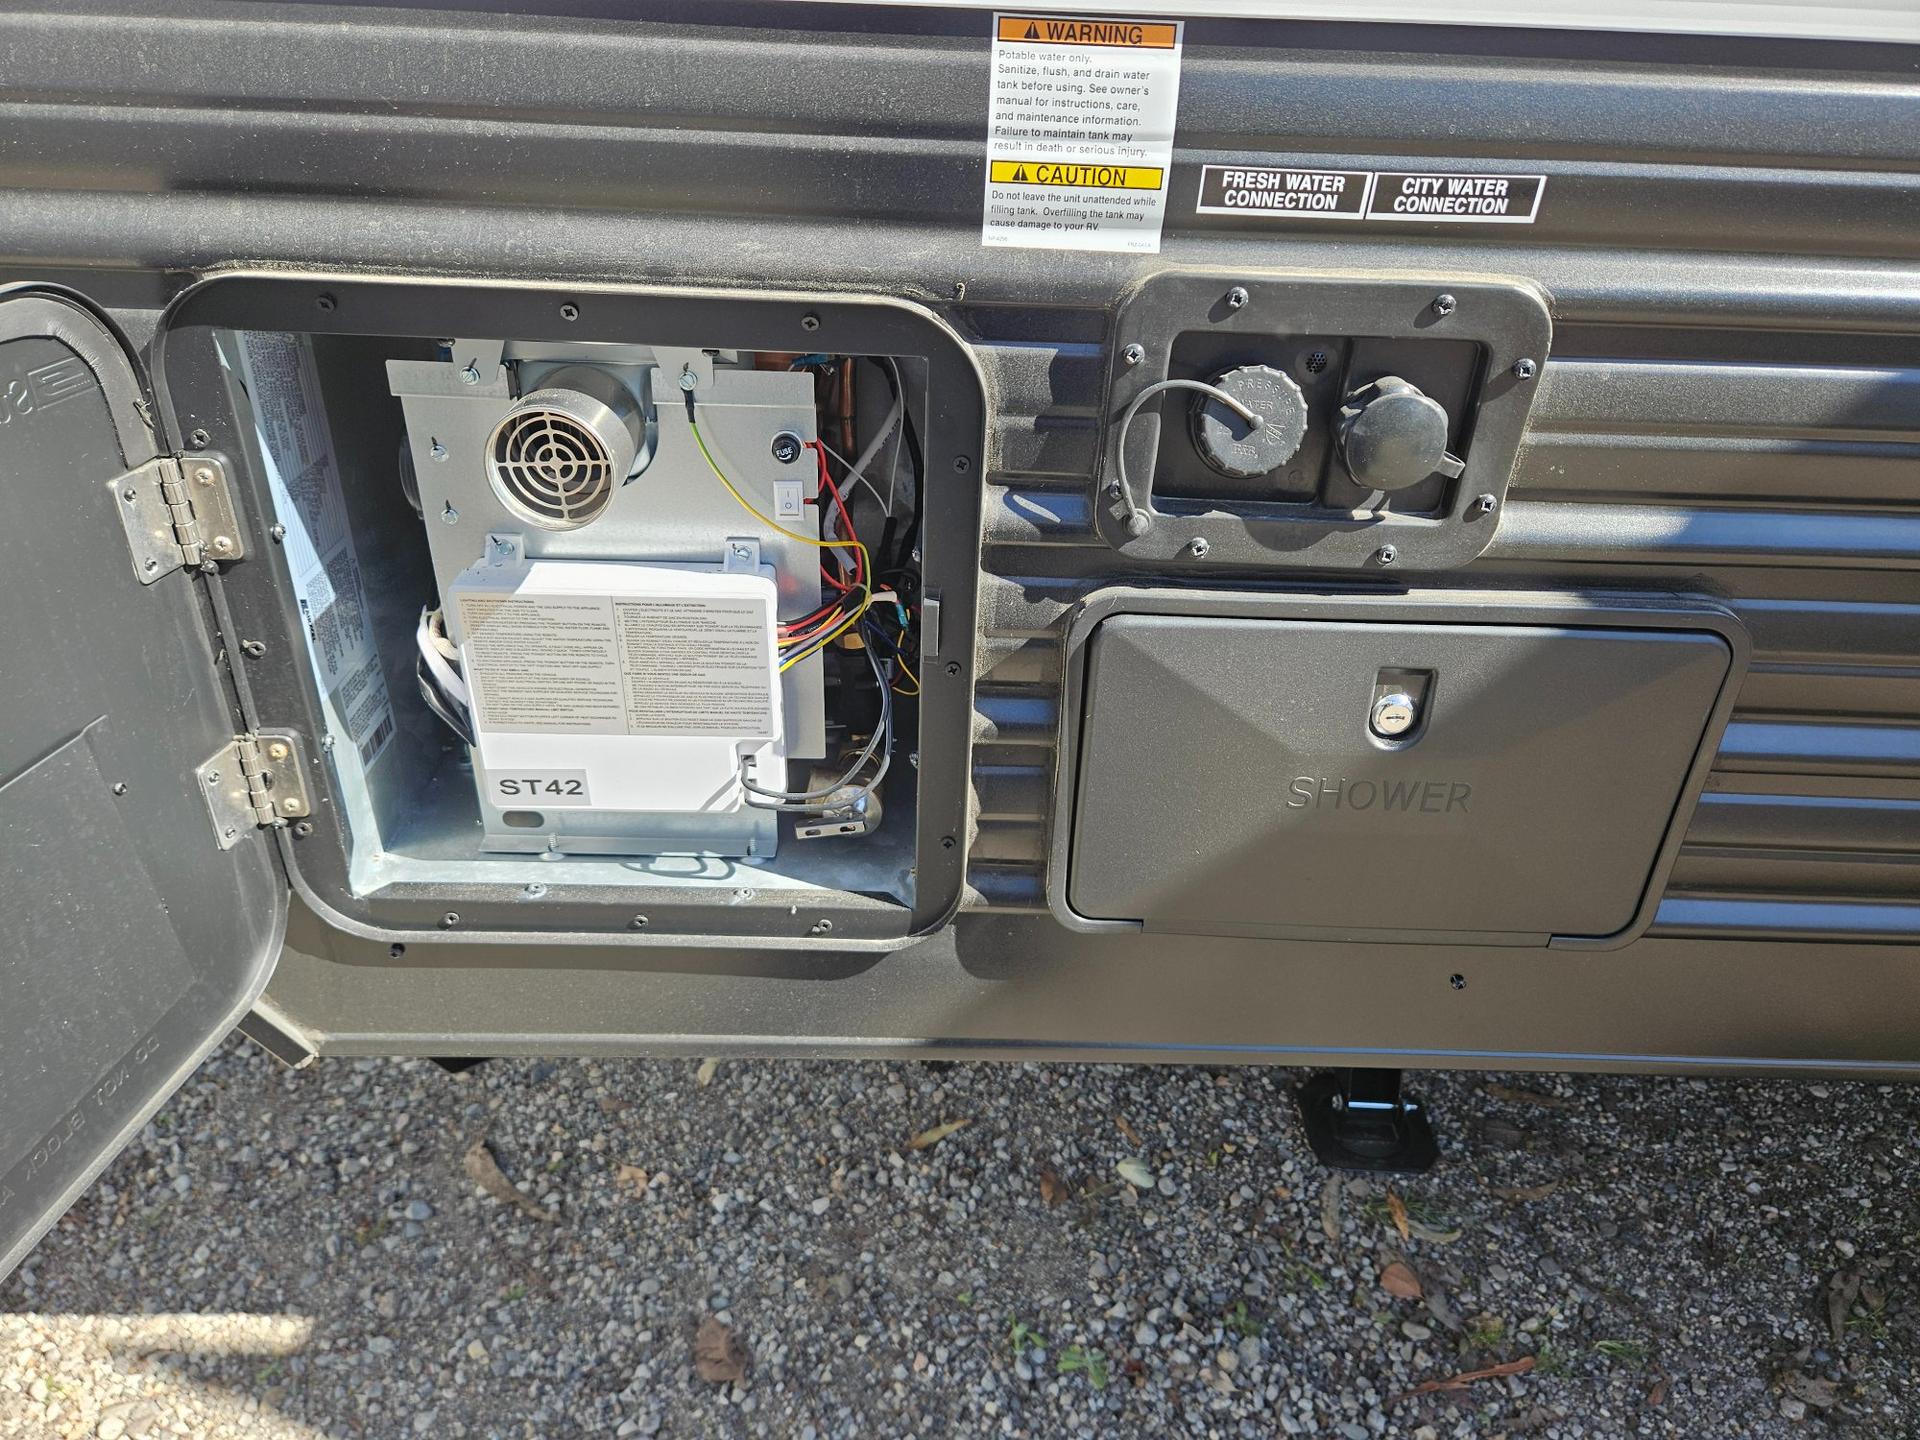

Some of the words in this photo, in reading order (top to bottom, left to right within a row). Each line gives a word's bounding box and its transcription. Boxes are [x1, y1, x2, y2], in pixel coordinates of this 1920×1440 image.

[1047, 22, 1143, 44] WARNING
[999, 51, 1035, 60] Potable
[1039, 53, 1065, 62] water
[1069, 54, 1092, 64] only.
[998, 65, 1039, 76] Sanitize,
[1043, 68, 1070, 77] flush,
[1073, 69, 1091, 77] and
[1095, 70, 1120, 79] drain
[1123, 72, 1150, 80] water
[997, 80, 1018, 89] tank
[1022, 82, 1052, 91] before
[1056, 84, 1085, 95] using.
[1089, 84, 1107, 93] See
[1111, 86, 1149, 95] owner's
[997, 97, 1032, 105] manual
[1035, 97, 1048, 106] for
[1117, 102, 1140, 111] care,
[996, 112, 1013, 121] and
[1017, 113, 1079, 123] maintenance
[1082, 116, 1141, 126] information.
[995, 126, 1028, 136] Failure
[1031, 128, 1040, 137] to
[1044, 129, 1085, 139] maintain
[1089, 131, 1109, 140] tank
[1112, 132, 1132, 142] may
[994, 142, 1021, 151] result
[1025, 143, 1033, 151] in
[1036, 144, 1063, 153] death
[1080, 146, 1114, 155] serious
[1118, 147, 1147, 157] injury.
[1036, 165, 1126, 185] CAUTION
[1222, 171, 1280, 189] FRESH
[1286, 174, 1345, 192] WATER
[1402, 178, 1443, 195] CITY
[1449, 179, 1508, 196] WATER
[992, 191, 1003, 199] Do
[1007, 192, 1020, 200] not
[1023, 192, 1045, 202] leave
[1048, 193, 1061, 202] the
[1064, 194, 1080, 203] unit
[1083, 195, 1131, 205] unattended
[1134, 197, 1156, 206] while
[1224, 190, 1338, 210] CONNECTION
[1394, 196, 1509, 214] CONNECTION
[991, 206, 1014, 216] filling
[1017, 207, 1038, 216] tank.
[1043, 207, 1087, 219] Overfilling
[1090, 209, 1103, 218] the
[1105, 210, 1123, 219] tank
[1126, 212, 1144, 221] may
[1017, 220, 1051, 230] damage
[1065, 222, 1083, 231] your
[776, 447, 793, 456] FUSE
[500, 779, 583, 795] ST42
[1286, 776, 1472, 812] SHOWER
